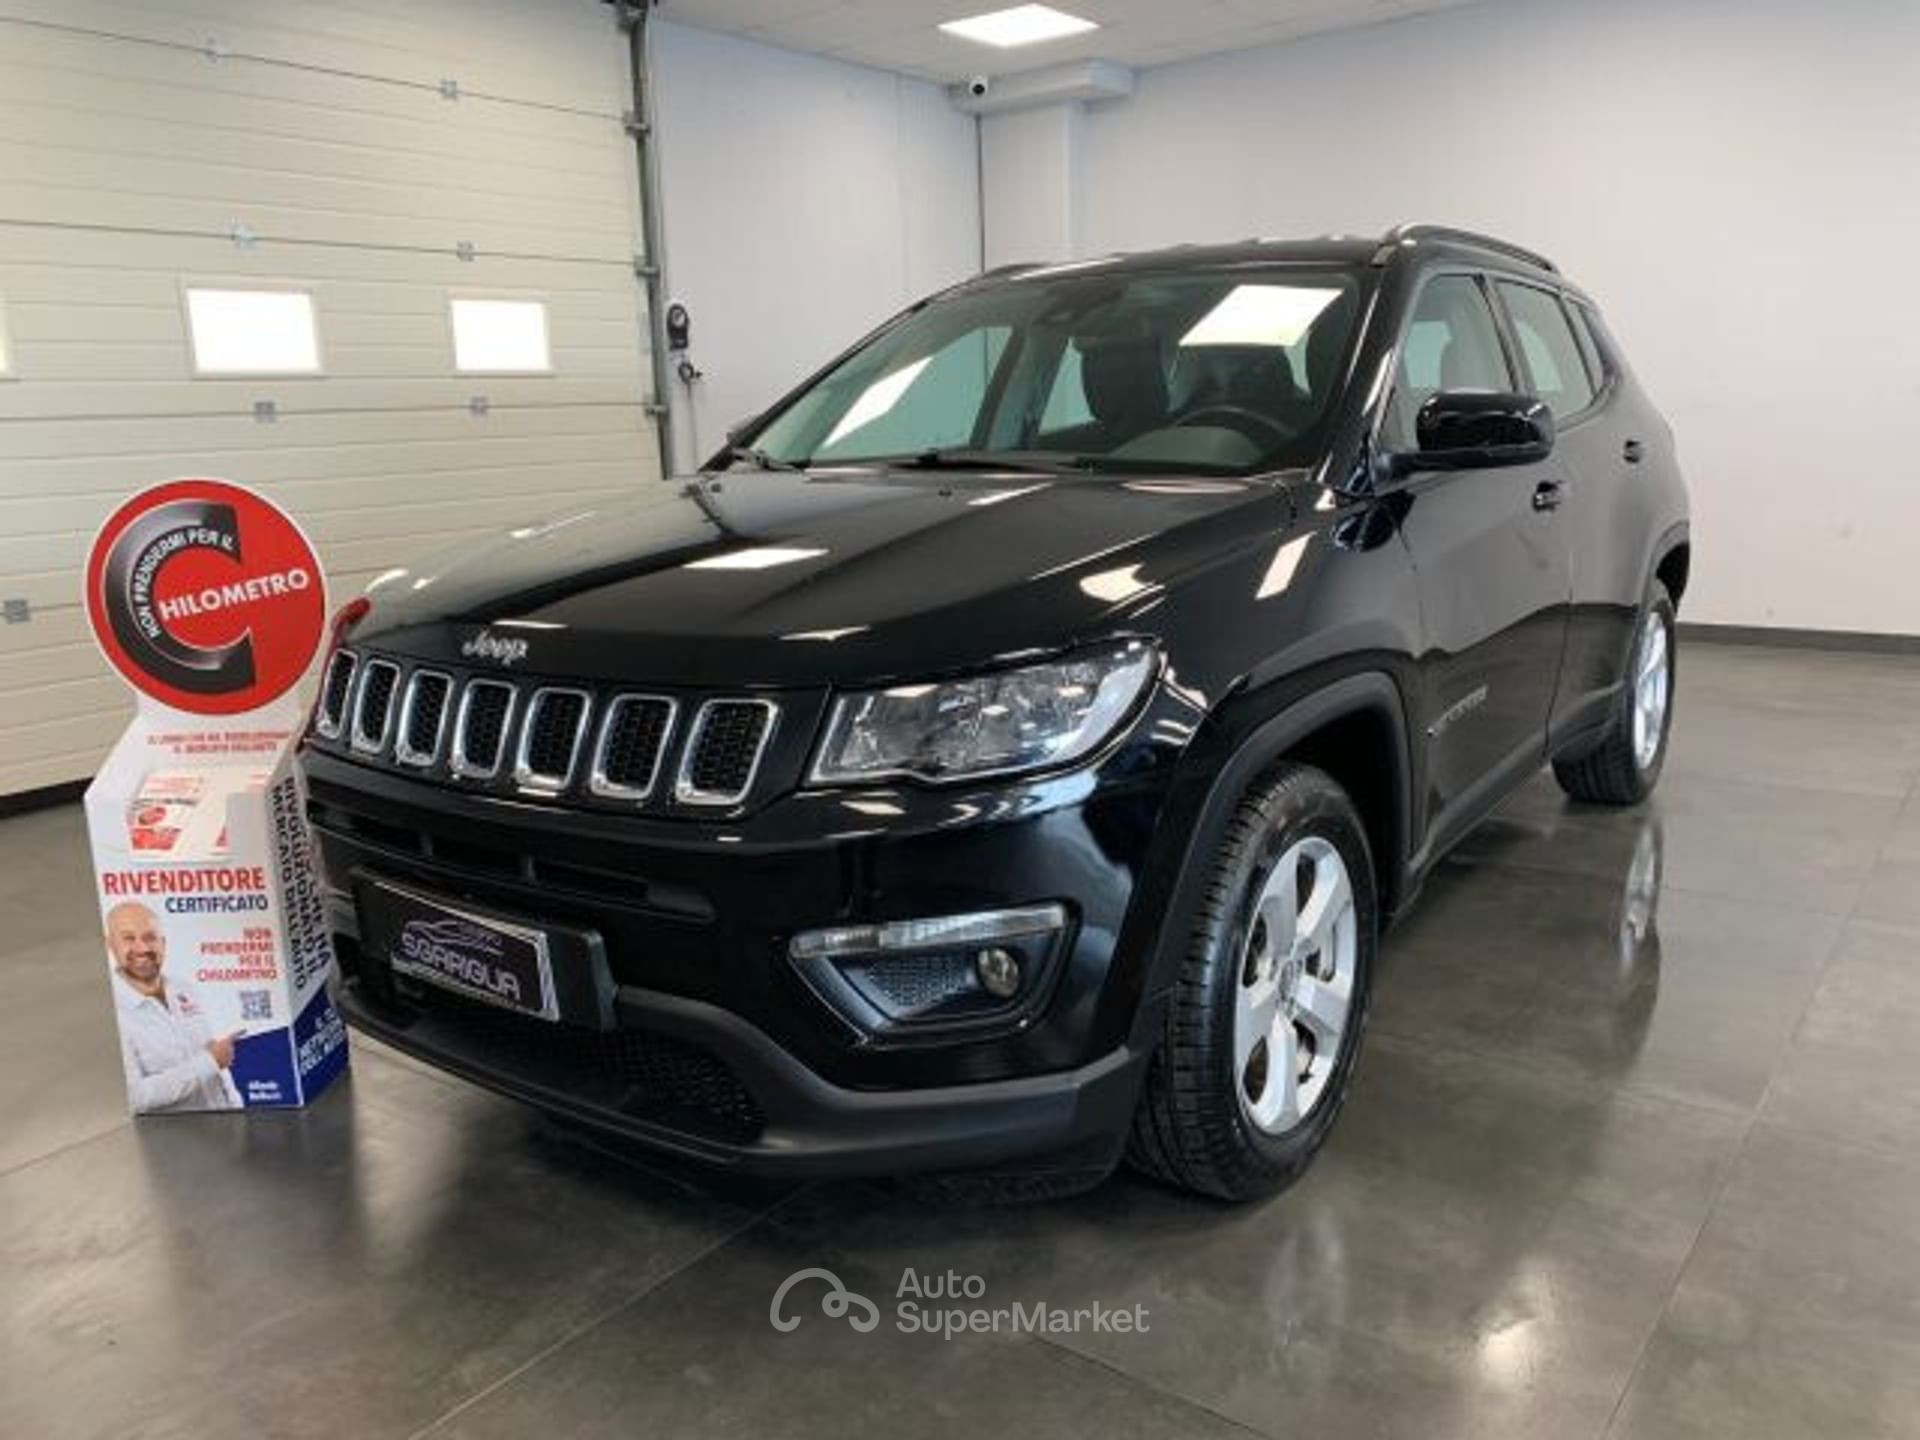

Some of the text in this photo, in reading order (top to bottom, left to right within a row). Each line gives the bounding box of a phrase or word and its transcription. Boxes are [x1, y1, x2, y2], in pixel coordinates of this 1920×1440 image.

[134, 532, 188, 603] PRENDERMI
[187, 528, 219, 547] PER
[158, 568, 310, 622] HILOMETRO
[462, 629, 528, 667] Jeep
[103, 866, 266, 895] RIVENDITORE
[164, 895, 269, 914] CERTIFICATO
